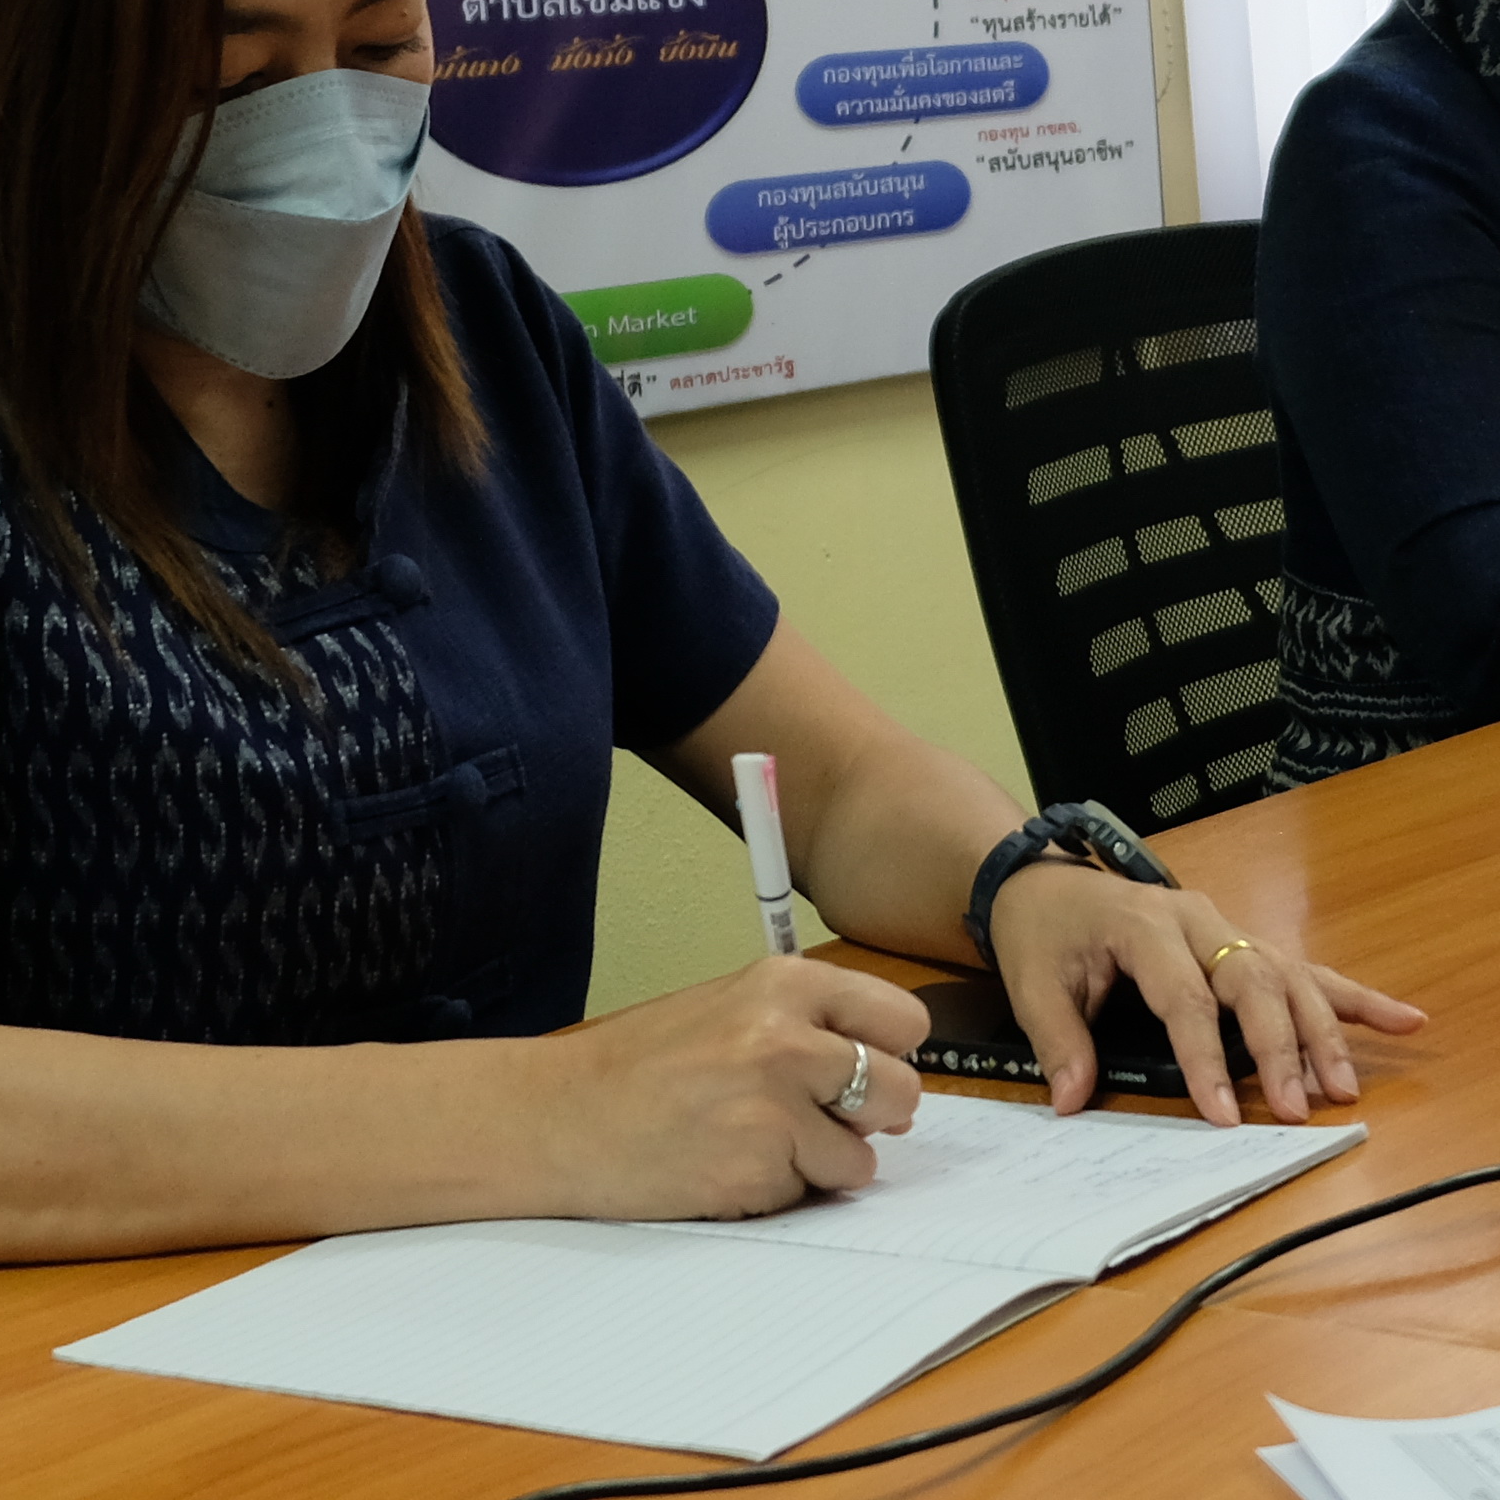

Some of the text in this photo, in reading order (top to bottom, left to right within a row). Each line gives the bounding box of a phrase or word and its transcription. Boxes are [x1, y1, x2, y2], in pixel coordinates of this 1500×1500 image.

[823, 48, 1024, 88] กองทุนเพื่อโอกาสและ
[757, 171, 926, 211] กองทุนสนับสนุน
[772, 206, 915, 249] ผู้ประกอบการ
[608, 306, 698, 337] Market
